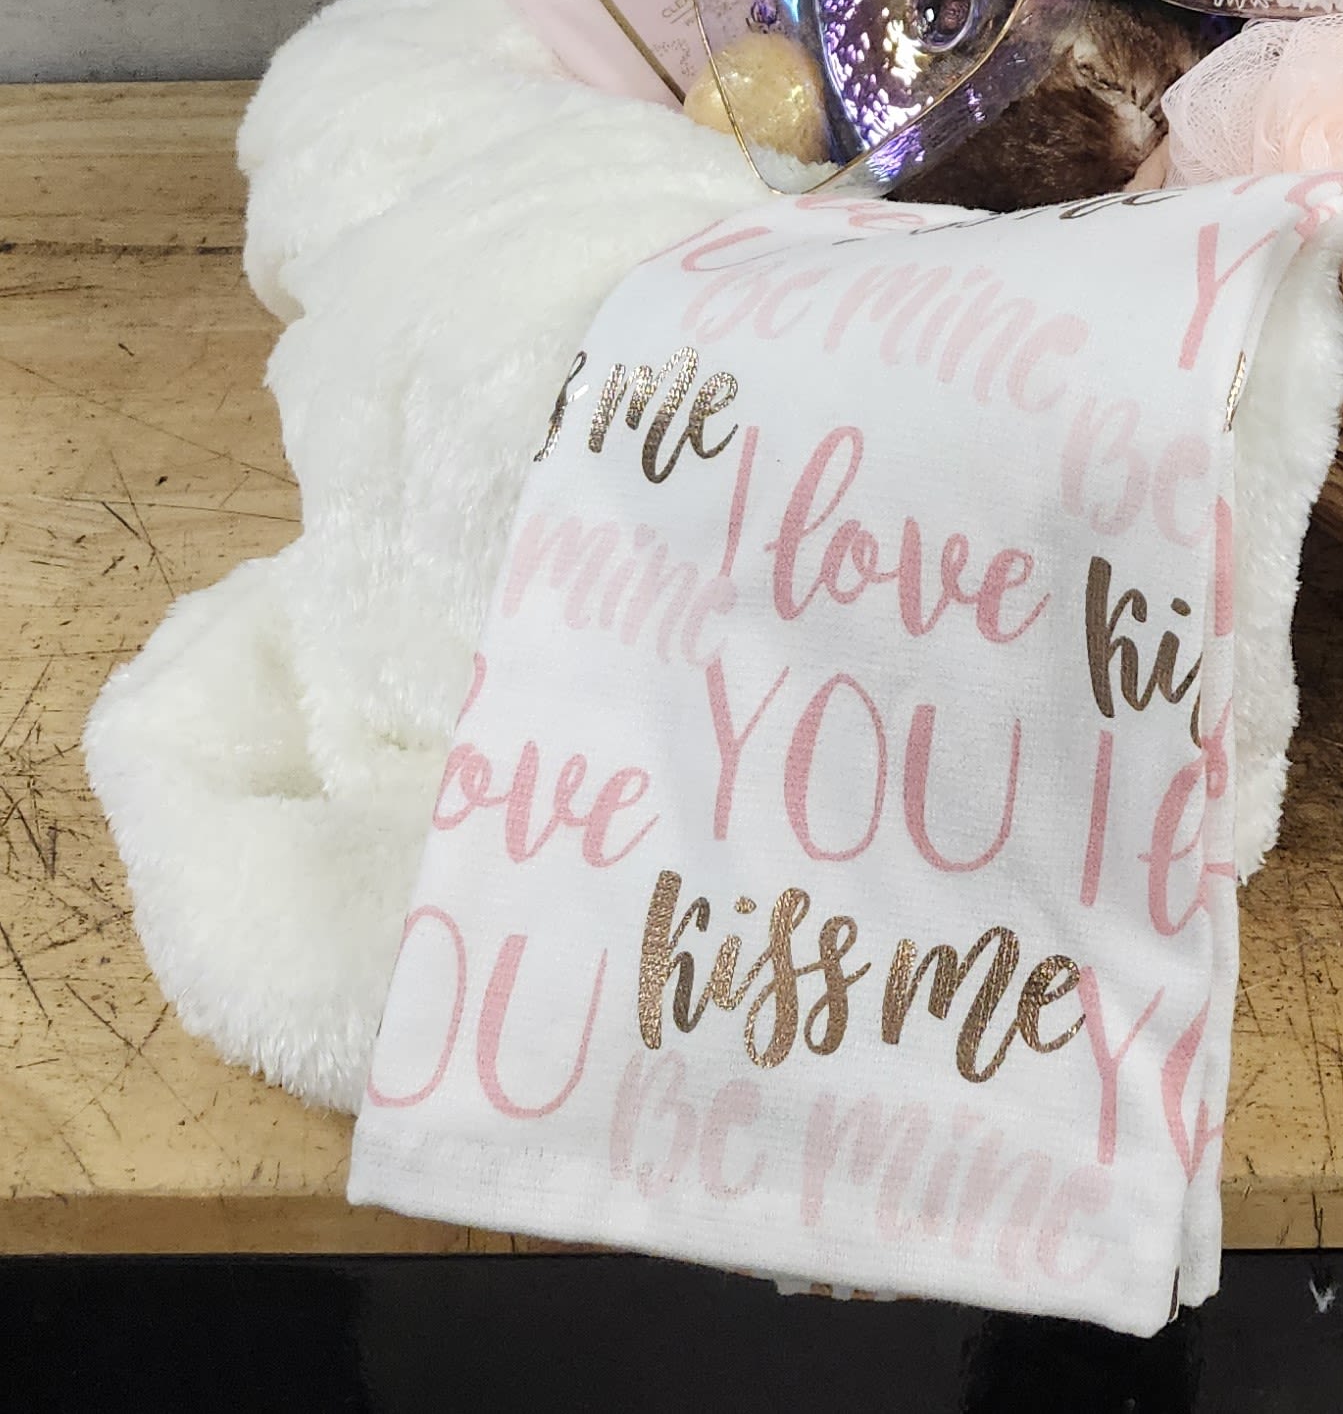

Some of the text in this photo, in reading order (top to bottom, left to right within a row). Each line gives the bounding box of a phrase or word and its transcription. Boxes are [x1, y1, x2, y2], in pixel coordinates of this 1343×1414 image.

[822, 258, 1092, 416] mine
[763, 424, 1051, 643] love
[704, 654, 1024, 874] YOU
[365, 902, 609, 1122] OU
[636, 868, 1088, 1084] kiss me
[798, 1091, 1113, 1283] mine
